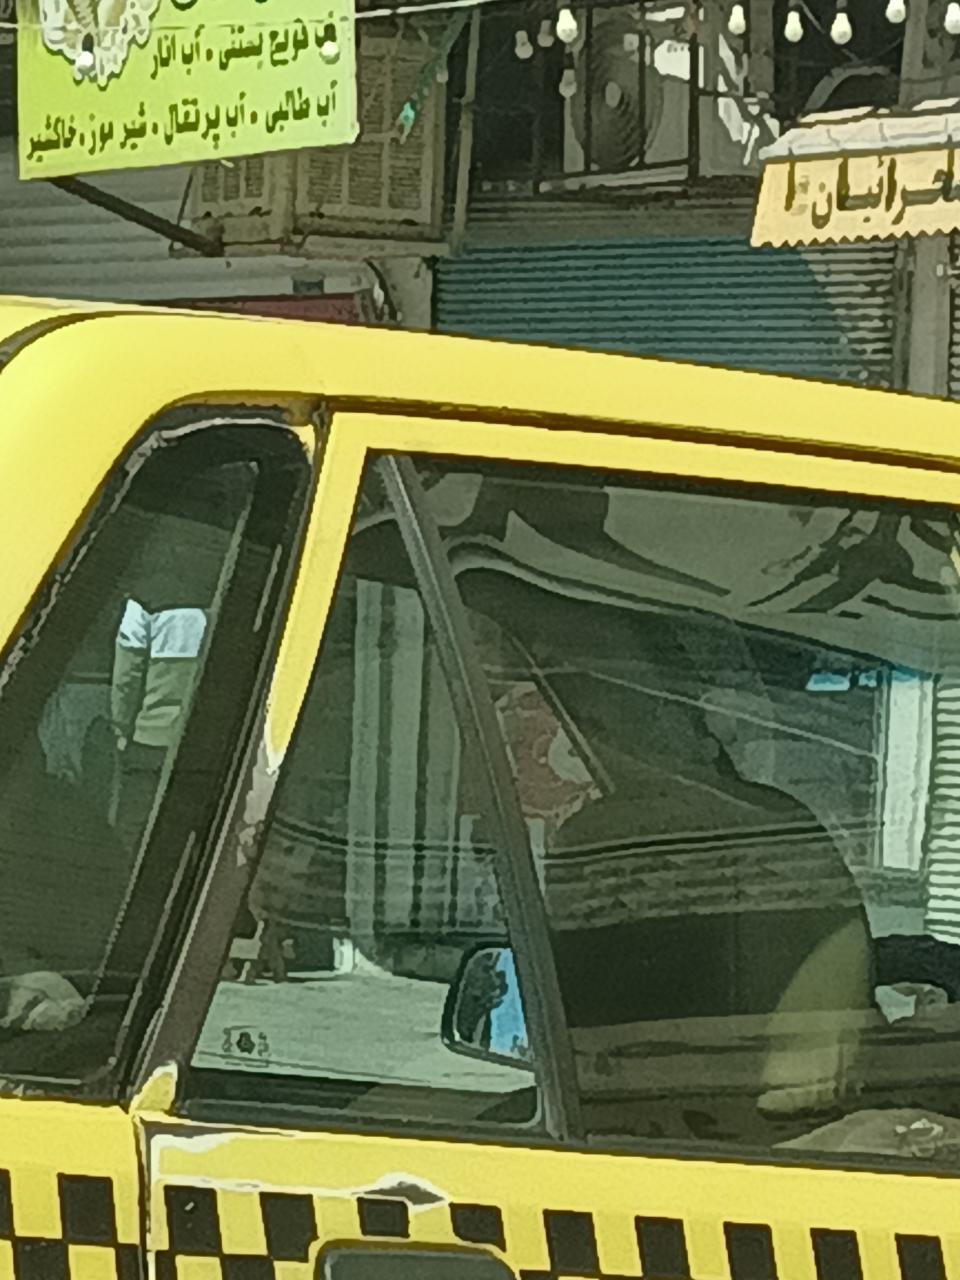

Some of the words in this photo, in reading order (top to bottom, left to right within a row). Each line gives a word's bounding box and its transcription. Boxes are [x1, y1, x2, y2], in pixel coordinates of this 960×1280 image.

[150, 33, 176, 80] انار
[181, 24, 206, 76] آب
[219, 24, 264, 71] بستنی
[119, 101, 147, 150] شیر
[163, 97, 221, 150] پرتقال
[225, 91, 246, 138] آب
[265, 86, 311, 133] طالبی
[316, 79, 338, 128] آب
[25, 113, 76, 162] خاکشیر
[87, 112, 114, 155] موز
[811, 156, 960, 230] حرائیان
